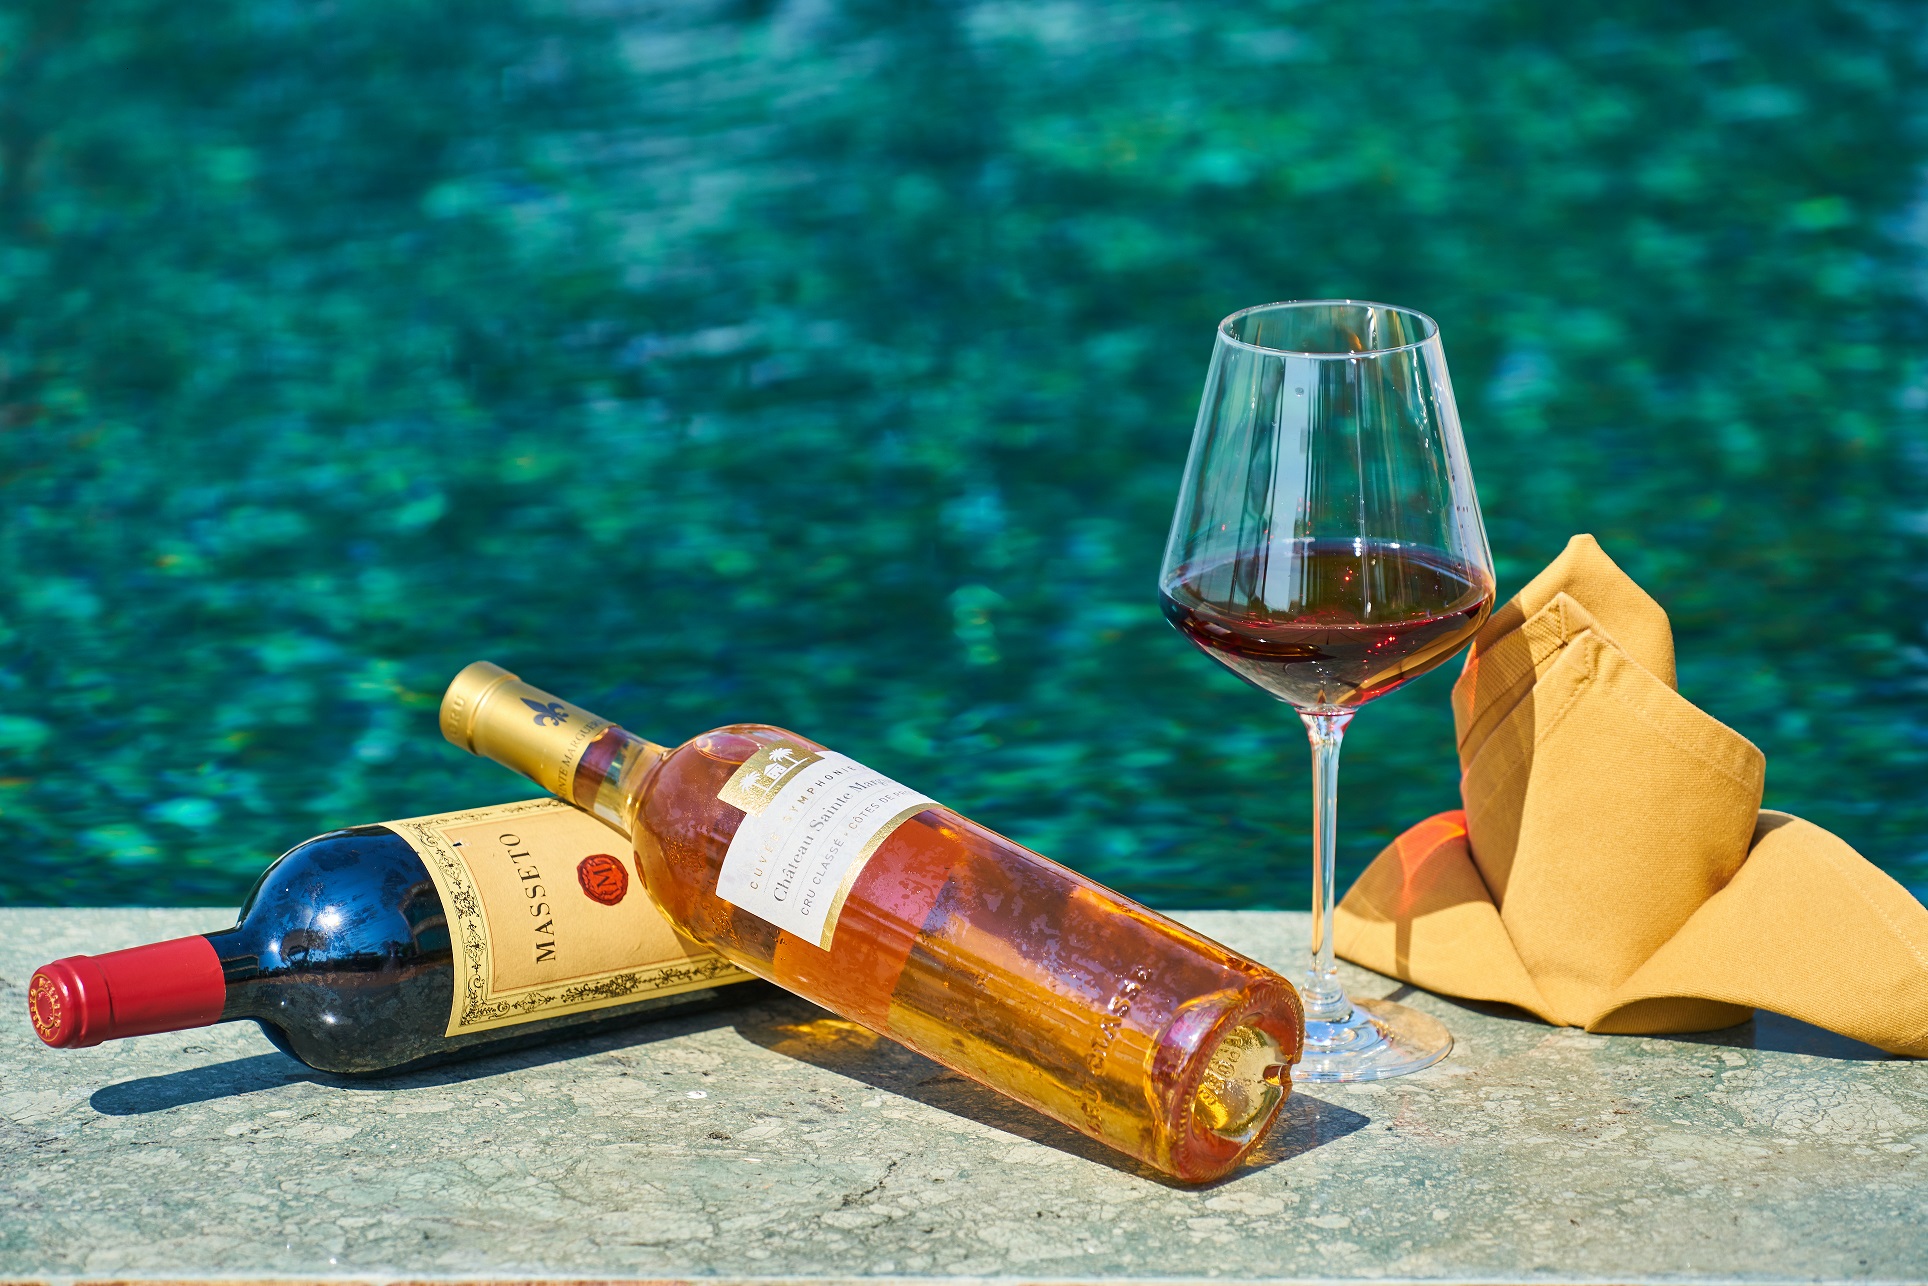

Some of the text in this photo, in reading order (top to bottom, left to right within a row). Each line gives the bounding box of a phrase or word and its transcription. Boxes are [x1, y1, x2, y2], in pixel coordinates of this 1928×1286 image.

[773, 835, 814, 902] Château
[809, 791, 853, 833] Sainte
[782, 765, 857, 823] SYMPHONIE
[498, 833, 556, 964] MASSETO
[800, 889, 816, 916] CRU
[812, 838, 845, 886] CLASSÉ
[848, 802, 880, 830] CÔTES
[878, 794, 895, 805] DE
